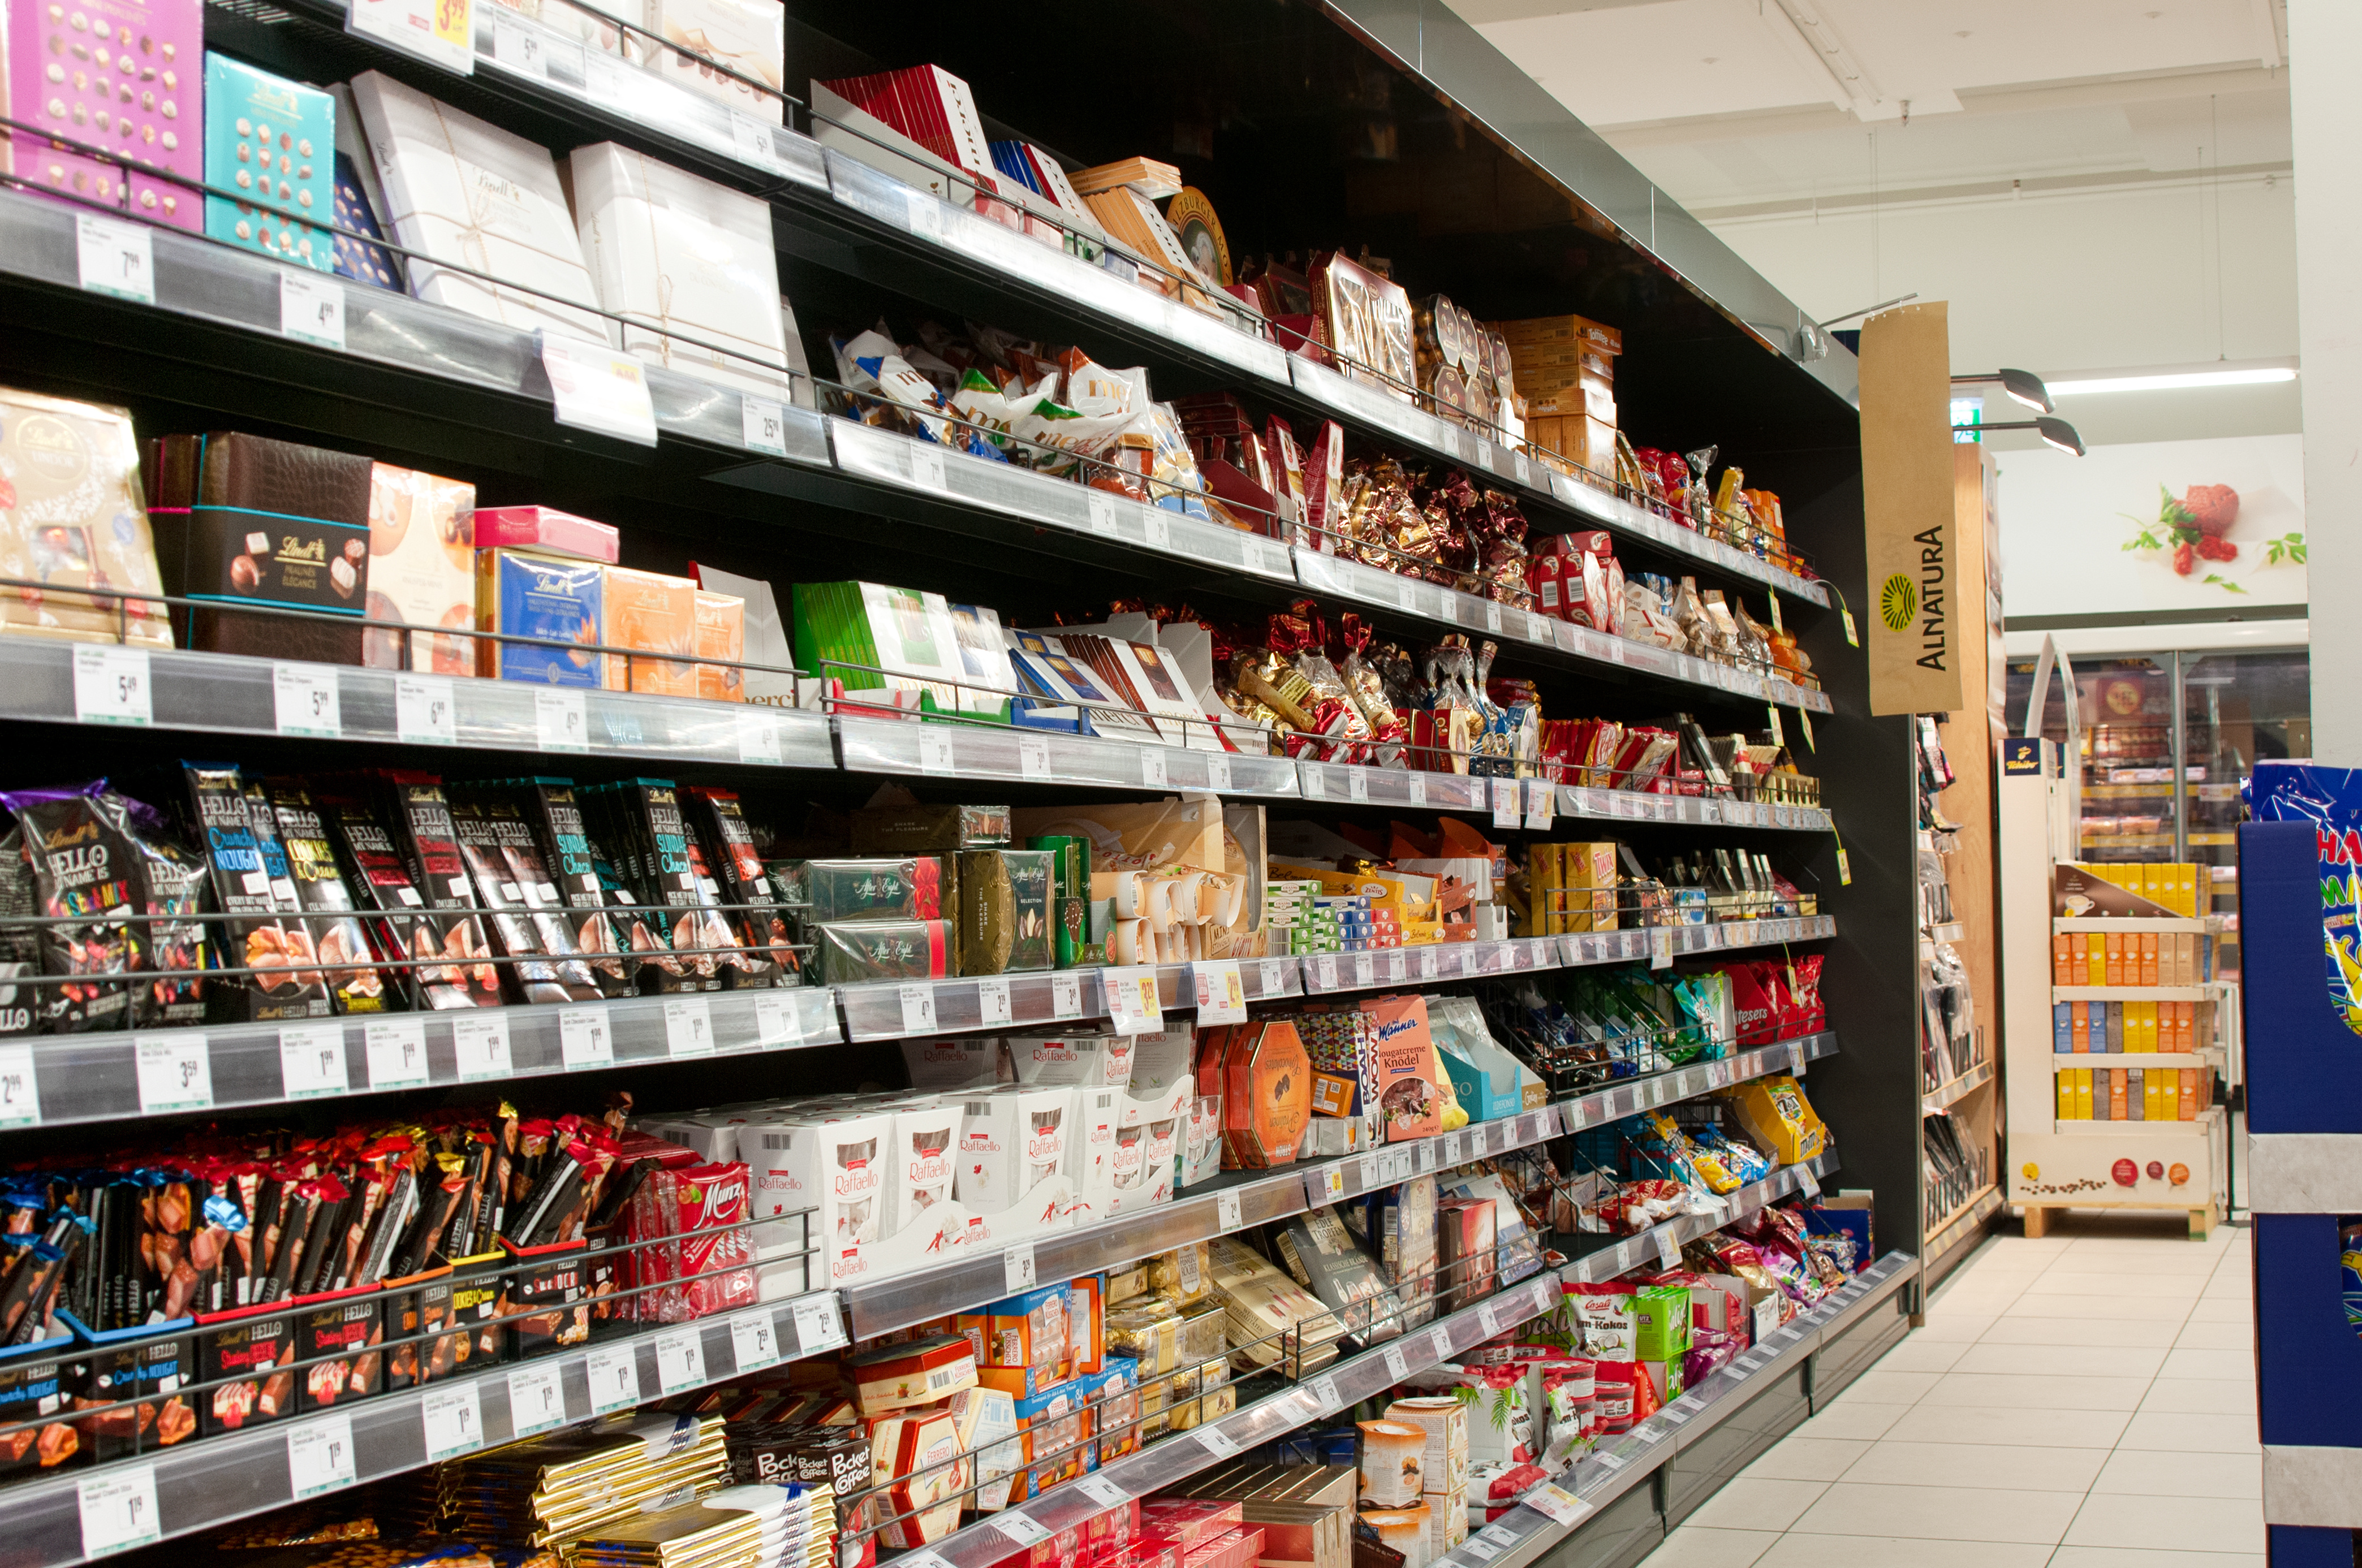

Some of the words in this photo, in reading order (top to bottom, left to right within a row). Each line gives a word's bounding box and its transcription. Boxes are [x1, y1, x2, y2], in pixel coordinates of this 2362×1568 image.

[278, 536, 318, 559] Lindt
[534, 573, 566, 594] Lindt
[1915, 525, 1946, 671] ALNATURA
[649, 789, 669, 803] Lindt
[199, 796, 249, 816] HELLO
[409, 808, 449, 826] HELLO
[548, 807, 582, 824] HELLO
[650, 808, 680, 824] HELLO
[455, 820, 493, 836] HELLO
[492, 822, 531, 837] HELLO
[722, 820, 749, 836] HELLO
[47, 845, 109, 875] HELLO
[1014, 867, 1029, 882] After
[1031, 866, 1046, 881] Eight
[855, 878, 877, 899] After
[881, 877, 901, 897] Eight
[1364, 887, 1385, 896] ZENTIS
[1213, 925, 1230, 940] MINI
[869, 944, 891, 962] After
[894, 941, 914, 960] Eight
[680, 982, 696, 992] HELLO
[1379, 1018, 1419, 1042] Manner
[924, 1050, 968, 1062] Raffaello
[1033, 1049, 1077, 1062] Raffaello
[1384, 1054, 1420, 1068] Knödel
[1106, 1060, 1132, 1078] Raffaello
[1357, 1036, 1370, 1104] BOAH
[1370, 1036, 1379, 1103] WOW
[1091, 1130, 1113, 1143] Raffaello
[960, 1140, 1001, 1152] Raffaello
[1028, 1136, 1062, 1159] Raffaello
[1148, 1140, 1175, 1160] Raffaello
[1275, 1144, 1292, 1158] STROH
[1113, 1150, 1143, 1169] Raffaello
[910, 1161, 951, 1182] Raffaello
[758, 1177, 801, 1191] Raffaello
[835, 1170, 878, 1195] Raffaello
[693, 1181, 742, 1230] Munz
[1314, 1217, 1334, 1229] EDLE
[1312, 1225, 1345, 1241] TROPFEN
[833, 1257, 868, 1279] Raffaello
[1179, 1253, 1197, 1267] FERRERO
[1322, 1260, 1349, 1273] KLASSISCHE
[1348, 1254, 1368, 1267] BRÄNDE
[1180, 1263, 1199, 1277] ROCHER
[424, 1286, 447, 1303] HELLO
[344, 1302, 373, 1323] HELLO
[1585, 1299, 1611, 1311] Casali
[1231, 1303, 1264, 1333] SPEZIALITÄTEN
[1243, 1306, 1259, 1323] WEISSE
[251, 1321, 282, 1341] HELLO
[149, 1342, 178, 1360] HELLO
[28, 1364, 58, 1380] HELLO
[114, 1366, 148, 1385] Crunhy
[148, 1360, 179, 1379] NOUGAT
[955, 1362, 972, 1372] FERRERO
[1050, 1399, 1066, 1410] FERRERO
[831, 1445, 870, 1478] Pocket
[926, 1446, 950, 1463] FERRERO
[757, 1453, 798, 1477] Pock
[798, 1458, 827, 1470] Pocket
[800, 1468, 827, 1480] Coffee
[834, 1463, 870, 1496] Coffee
[1091, 1523, 1107, 1539] CHERI
[1032, 1548, 1050, 1566] CHERI
